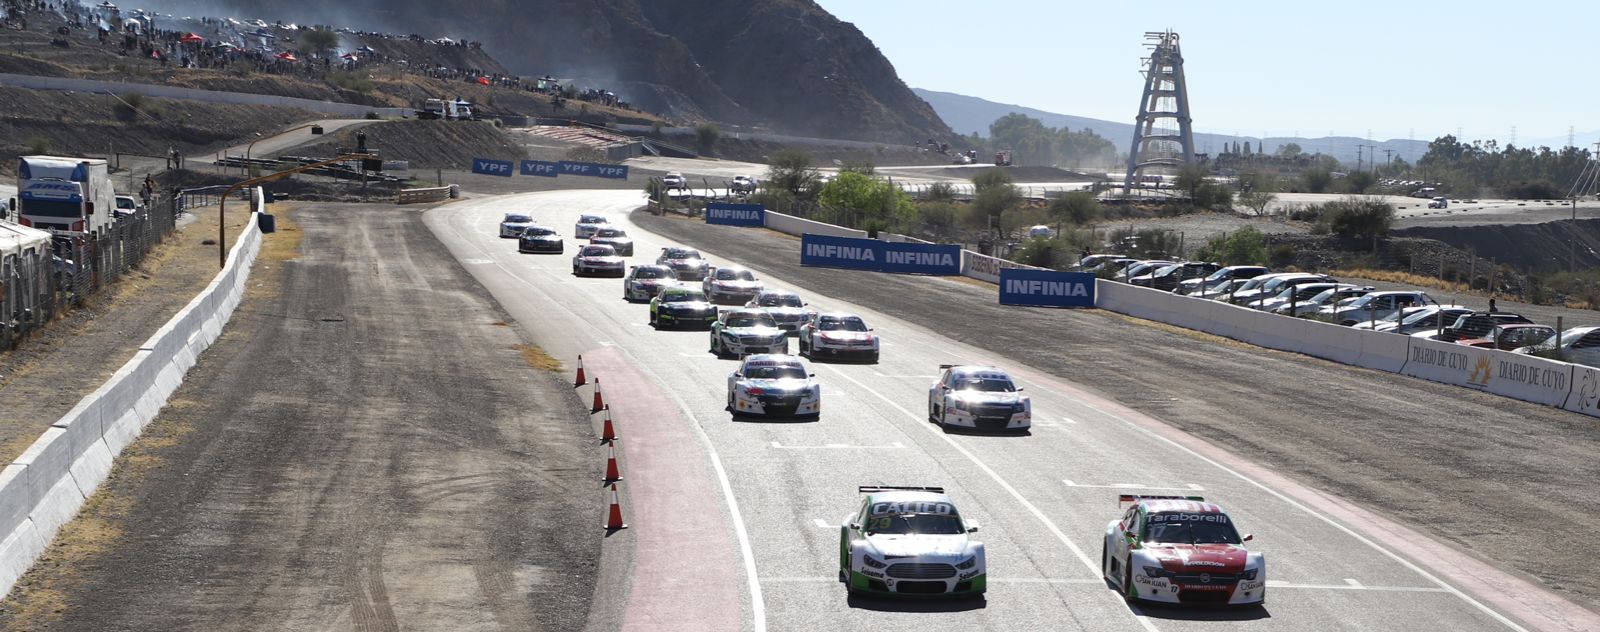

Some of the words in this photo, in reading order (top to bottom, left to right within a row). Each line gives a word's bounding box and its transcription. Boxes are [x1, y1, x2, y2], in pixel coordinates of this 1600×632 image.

[479, 161, 508, 172] YPF
[526, 163, 554, 173] YPF
[563, 164, 589, 173] YPF
[598, 167, 624, 176] YPF
[709, 208, 760, 220] INFINIA
[806, 243, 875, 262] INFINIA
[886, 250, 954, 266] INFINIA
[1005, 279, 1088, 296] INFINIA
[1413, 346, 1436, 366] DIARIO
[1437, 350, 1447, 367] DE
[1449, 352, 1468, 371] CUYO
[1500, 361, 1527, 382] DIARIO
[1528, 365, 1540, 385] DE
[1542, 369, 1565, 391] CUYO
[873, 501, 951, 515] CALICO
[1147, 512, 1227, 524] Taraborelli
[1170, 585, 1178, 593] 17
